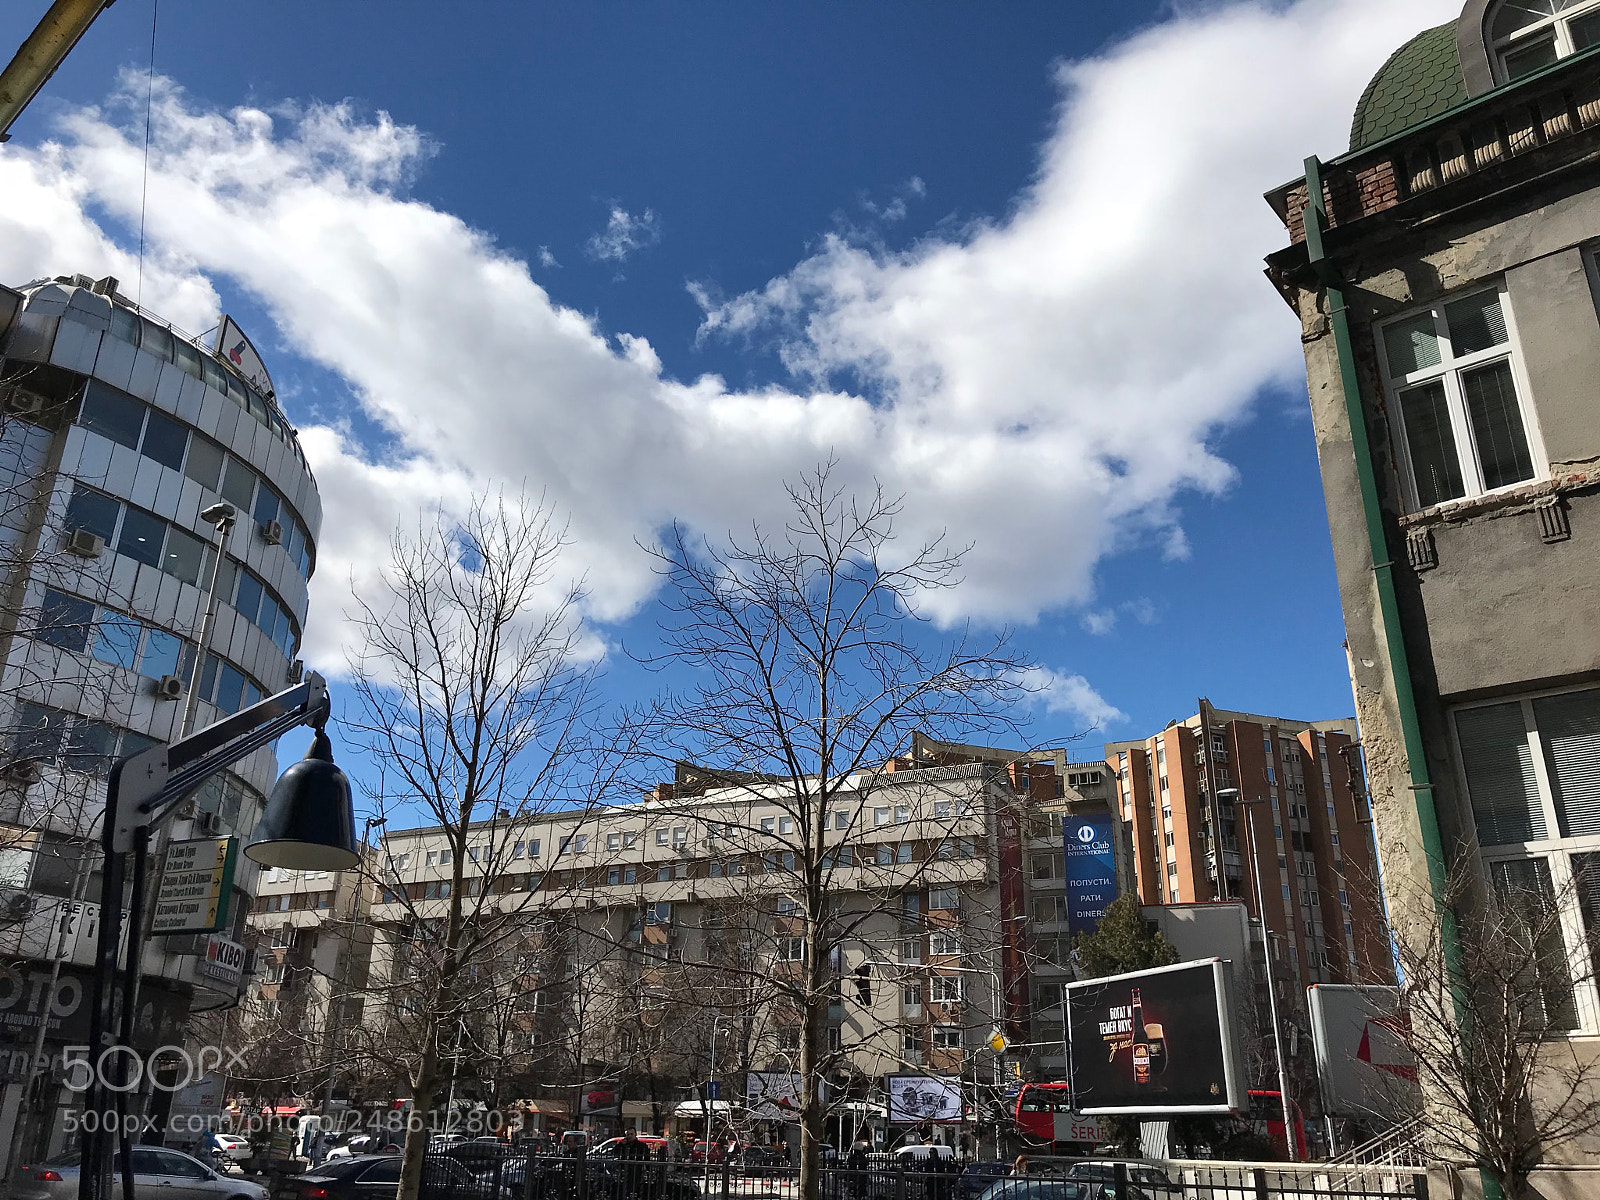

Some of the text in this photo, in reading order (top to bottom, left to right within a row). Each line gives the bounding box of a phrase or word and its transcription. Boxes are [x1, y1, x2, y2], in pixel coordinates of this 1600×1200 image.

[1067, 841, 1109, 851] Diners Club
[1067, 849, 1110, 857] INTERNATIONAL
[1070, 878, 1112, 887] ПОПУСТИ.
[1080, 894, 1104, 902] РАТИ.
[216, 941, 241, 969] KIBO
[1109, 1005, 1126, 1020] БОГАТ
